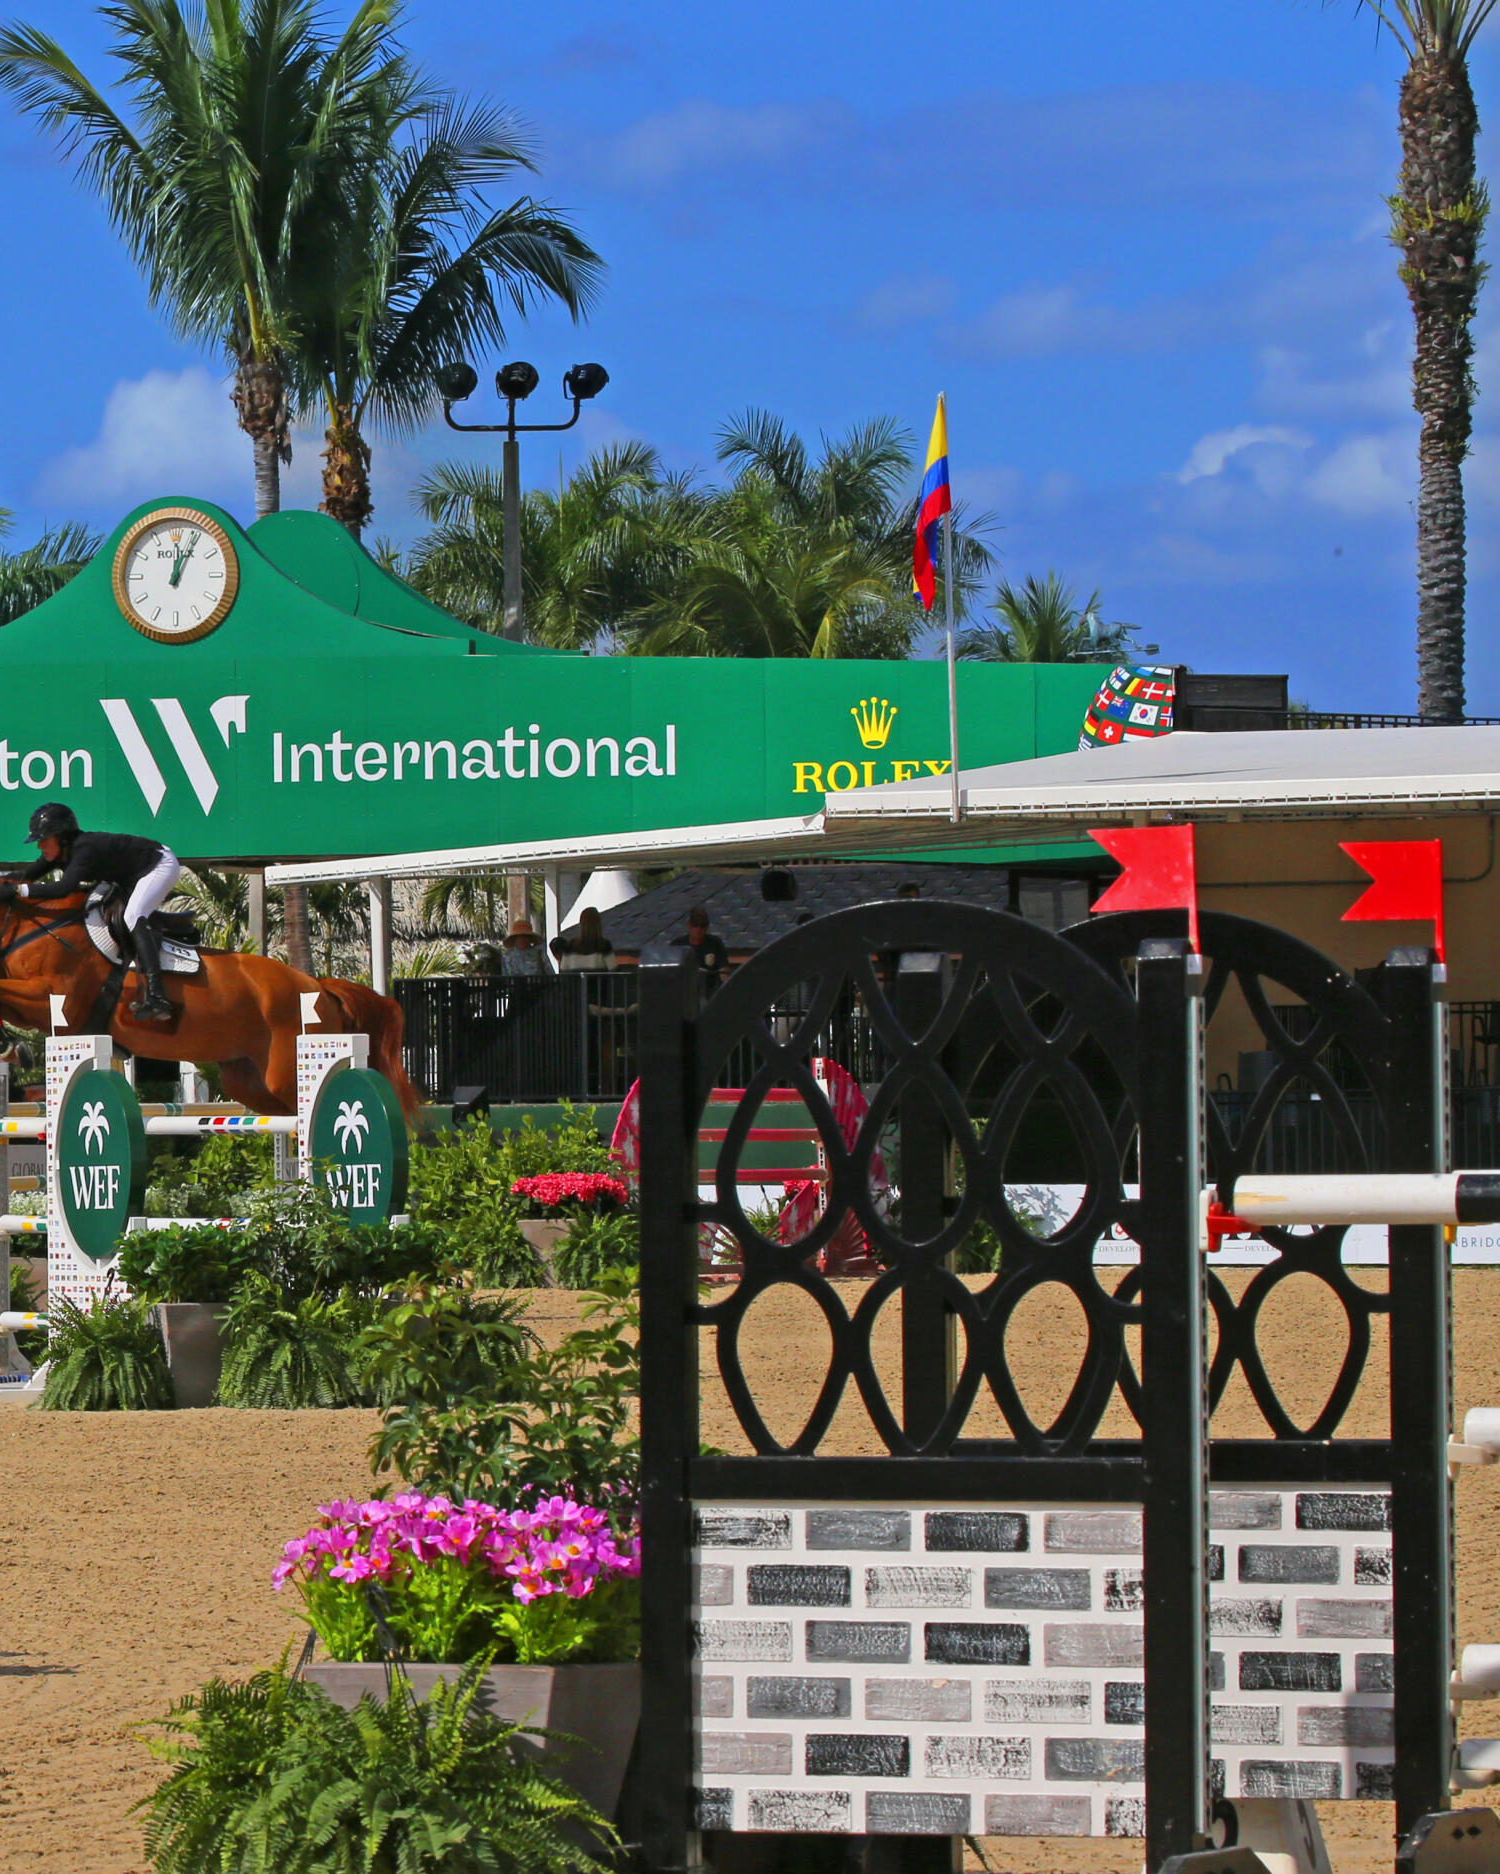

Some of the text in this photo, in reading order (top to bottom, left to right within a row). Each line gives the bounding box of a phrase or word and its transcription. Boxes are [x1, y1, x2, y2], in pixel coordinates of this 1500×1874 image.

[157, 550, 196, 559] ROX
[273, 723, 676, 783] International
[69, 1165, 121, 1210] WEF
[326, 1163, 372, 1208] WEF
